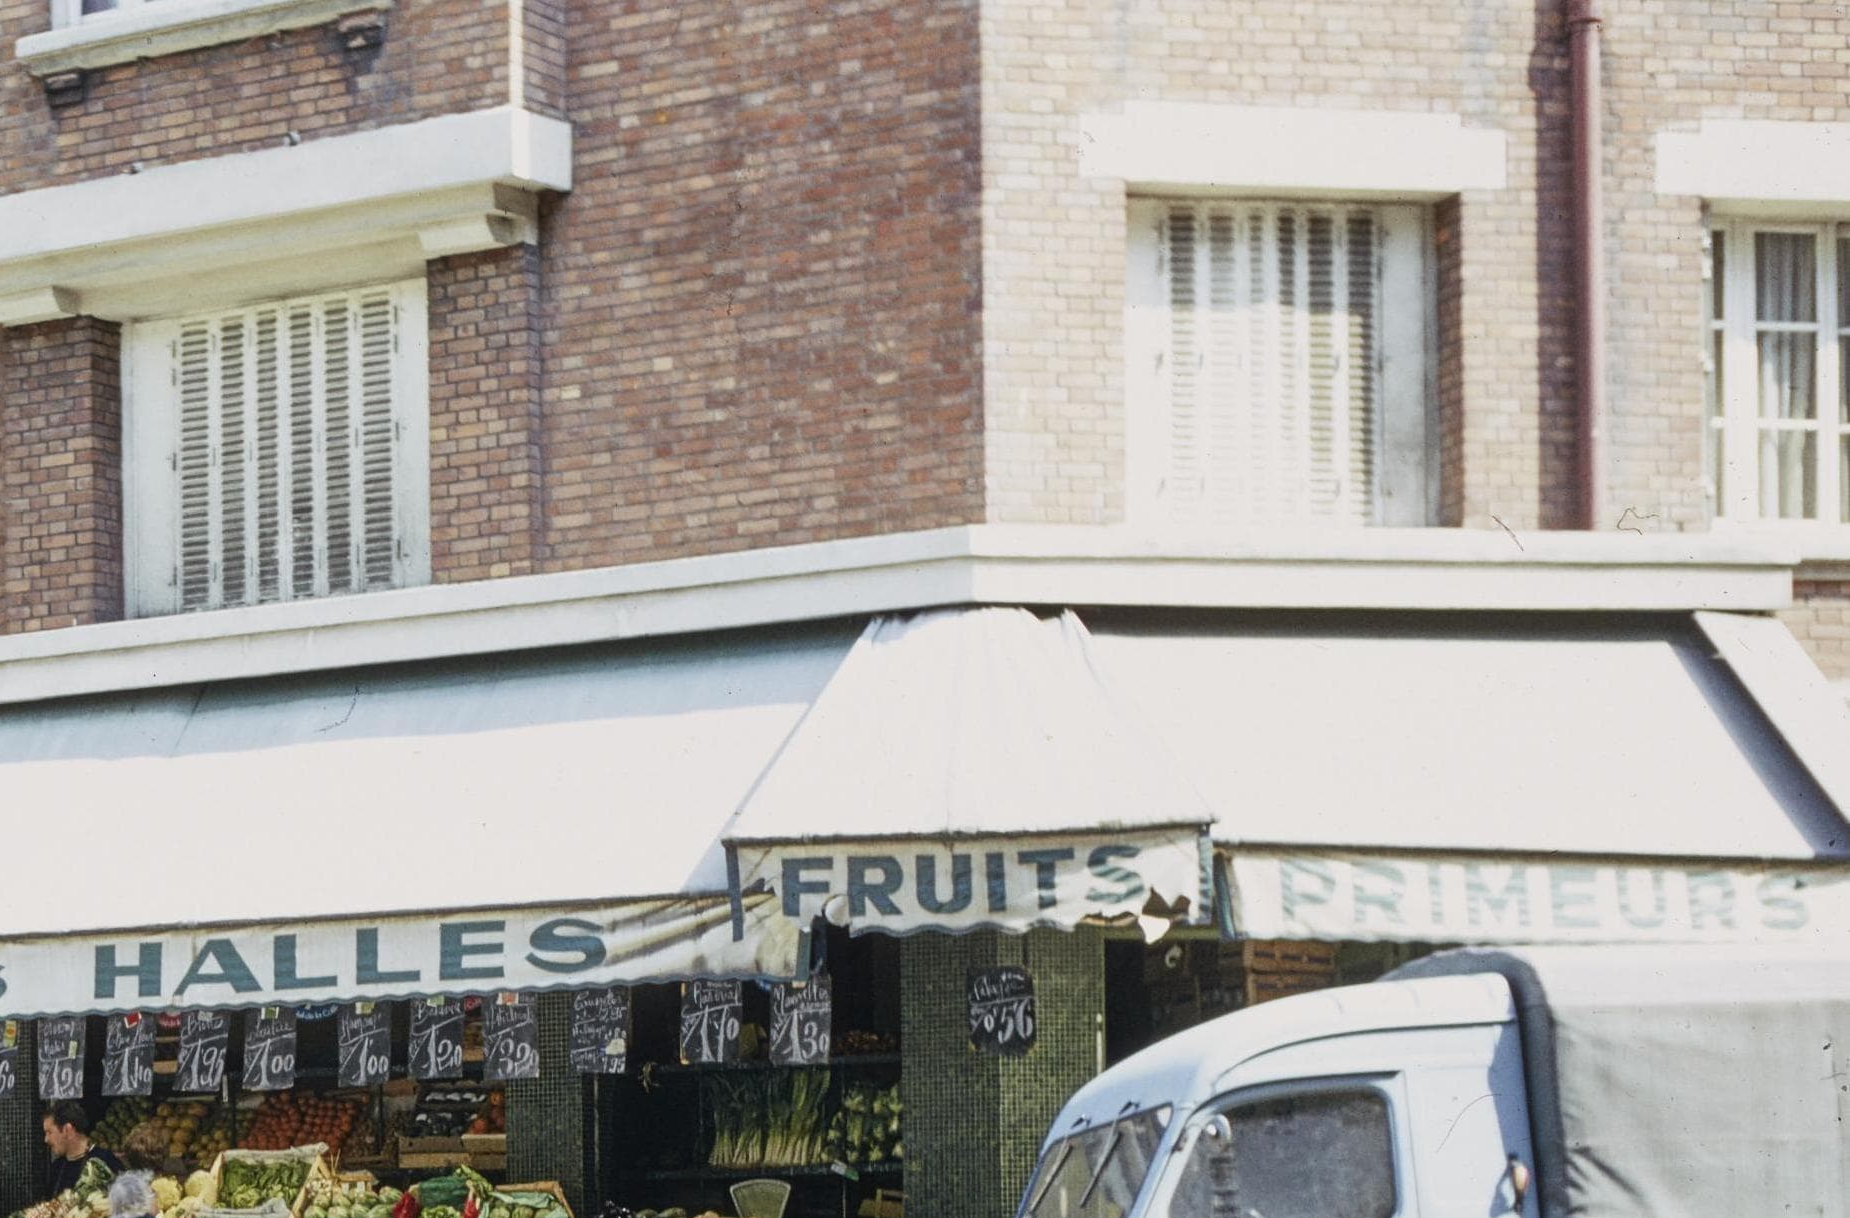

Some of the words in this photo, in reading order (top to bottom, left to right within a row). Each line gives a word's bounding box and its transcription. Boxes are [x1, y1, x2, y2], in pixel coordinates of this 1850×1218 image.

[780, 844, 1146, 918] FRUITS
[1280, 859, 1811, 930] PRIMEURS
[94, 918, 607, 1000] HALLES
